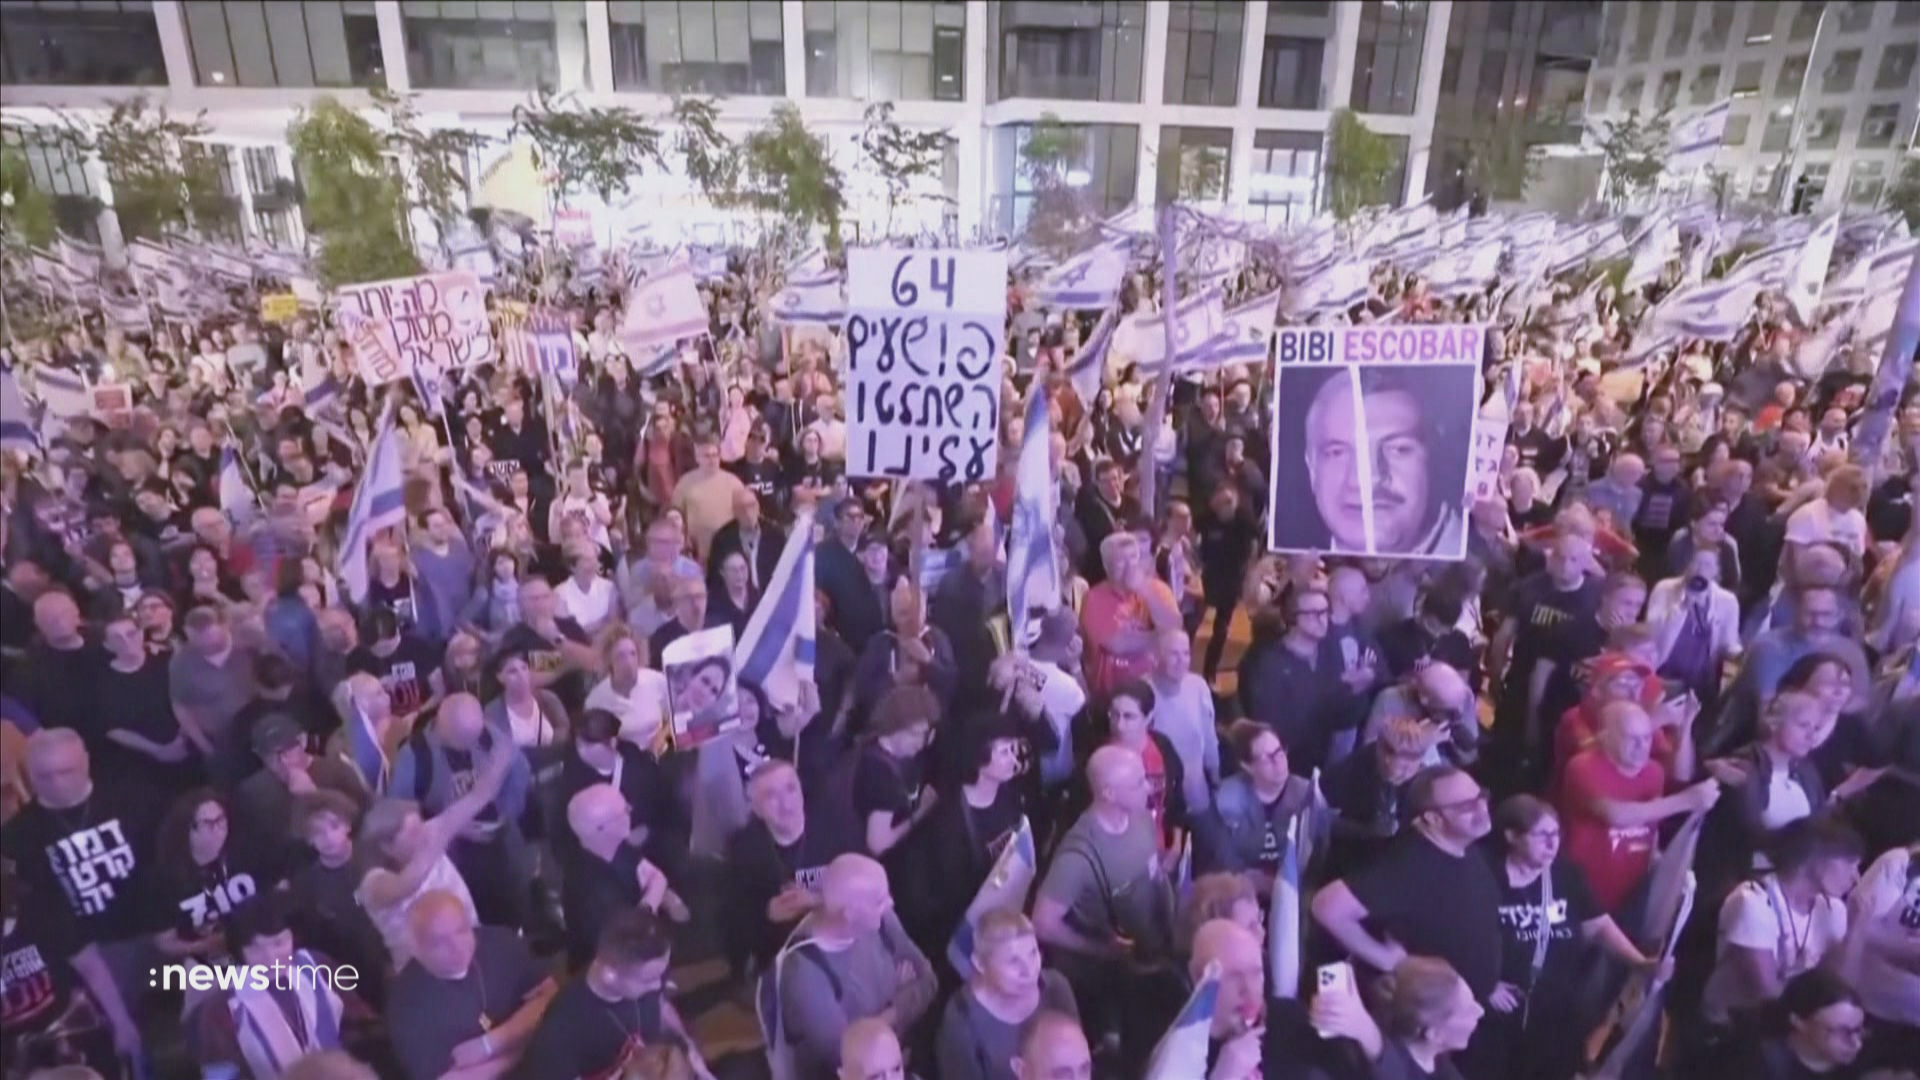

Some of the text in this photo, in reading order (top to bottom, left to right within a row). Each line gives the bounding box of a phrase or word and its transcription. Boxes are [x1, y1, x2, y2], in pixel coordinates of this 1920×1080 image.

[891, 255, 956, 308] 64
[847, 314, 996, 381] פושעים
[1280, 328, 1479, 362] BIBI ESCOBAR
[857, 380, 998, 431] השתלטו
[866, 429, 994, 481] עלינו
